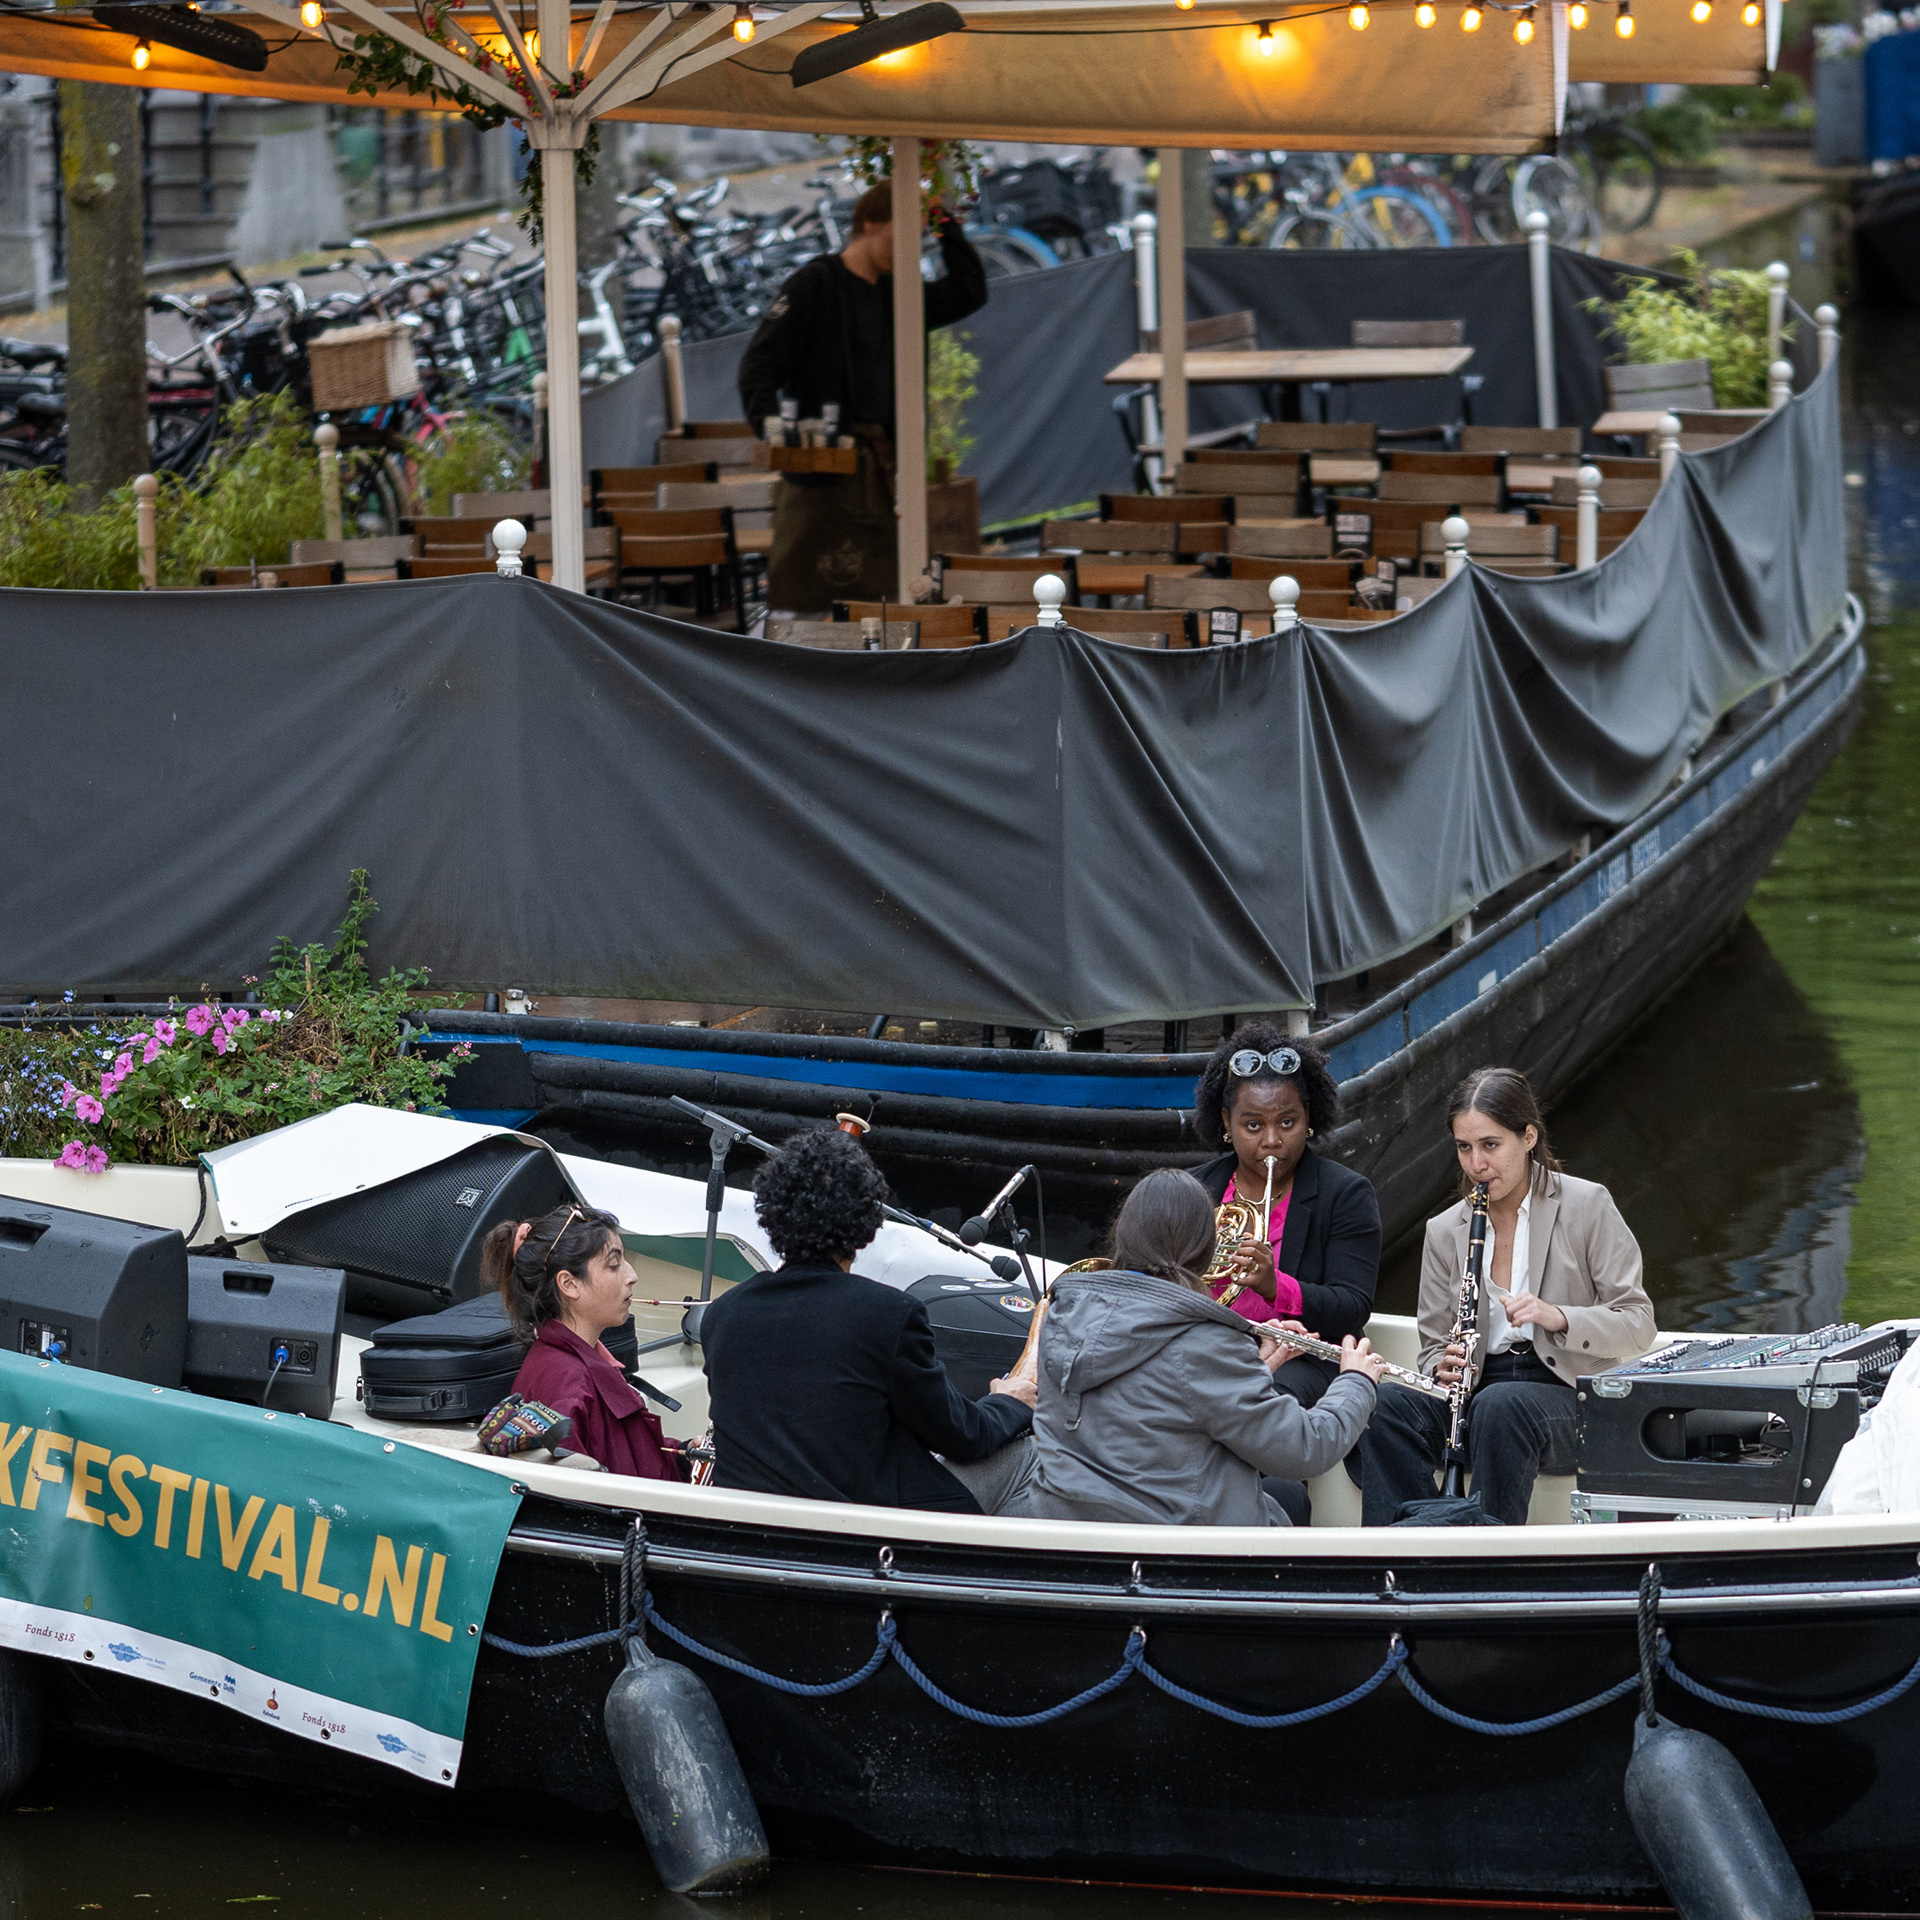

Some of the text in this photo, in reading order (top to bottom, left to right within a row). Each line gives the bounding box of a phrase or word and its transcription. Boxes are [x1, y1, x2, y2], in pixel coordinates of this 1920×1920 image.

[25, 1623, 76, 1643] Fonds 1818
[189, 1671, 236, 1695] Gemeente Delft
[262, 1709, 281, 1721] Rabobank
[302, 1711, 346, 1734] Fonds 1818
